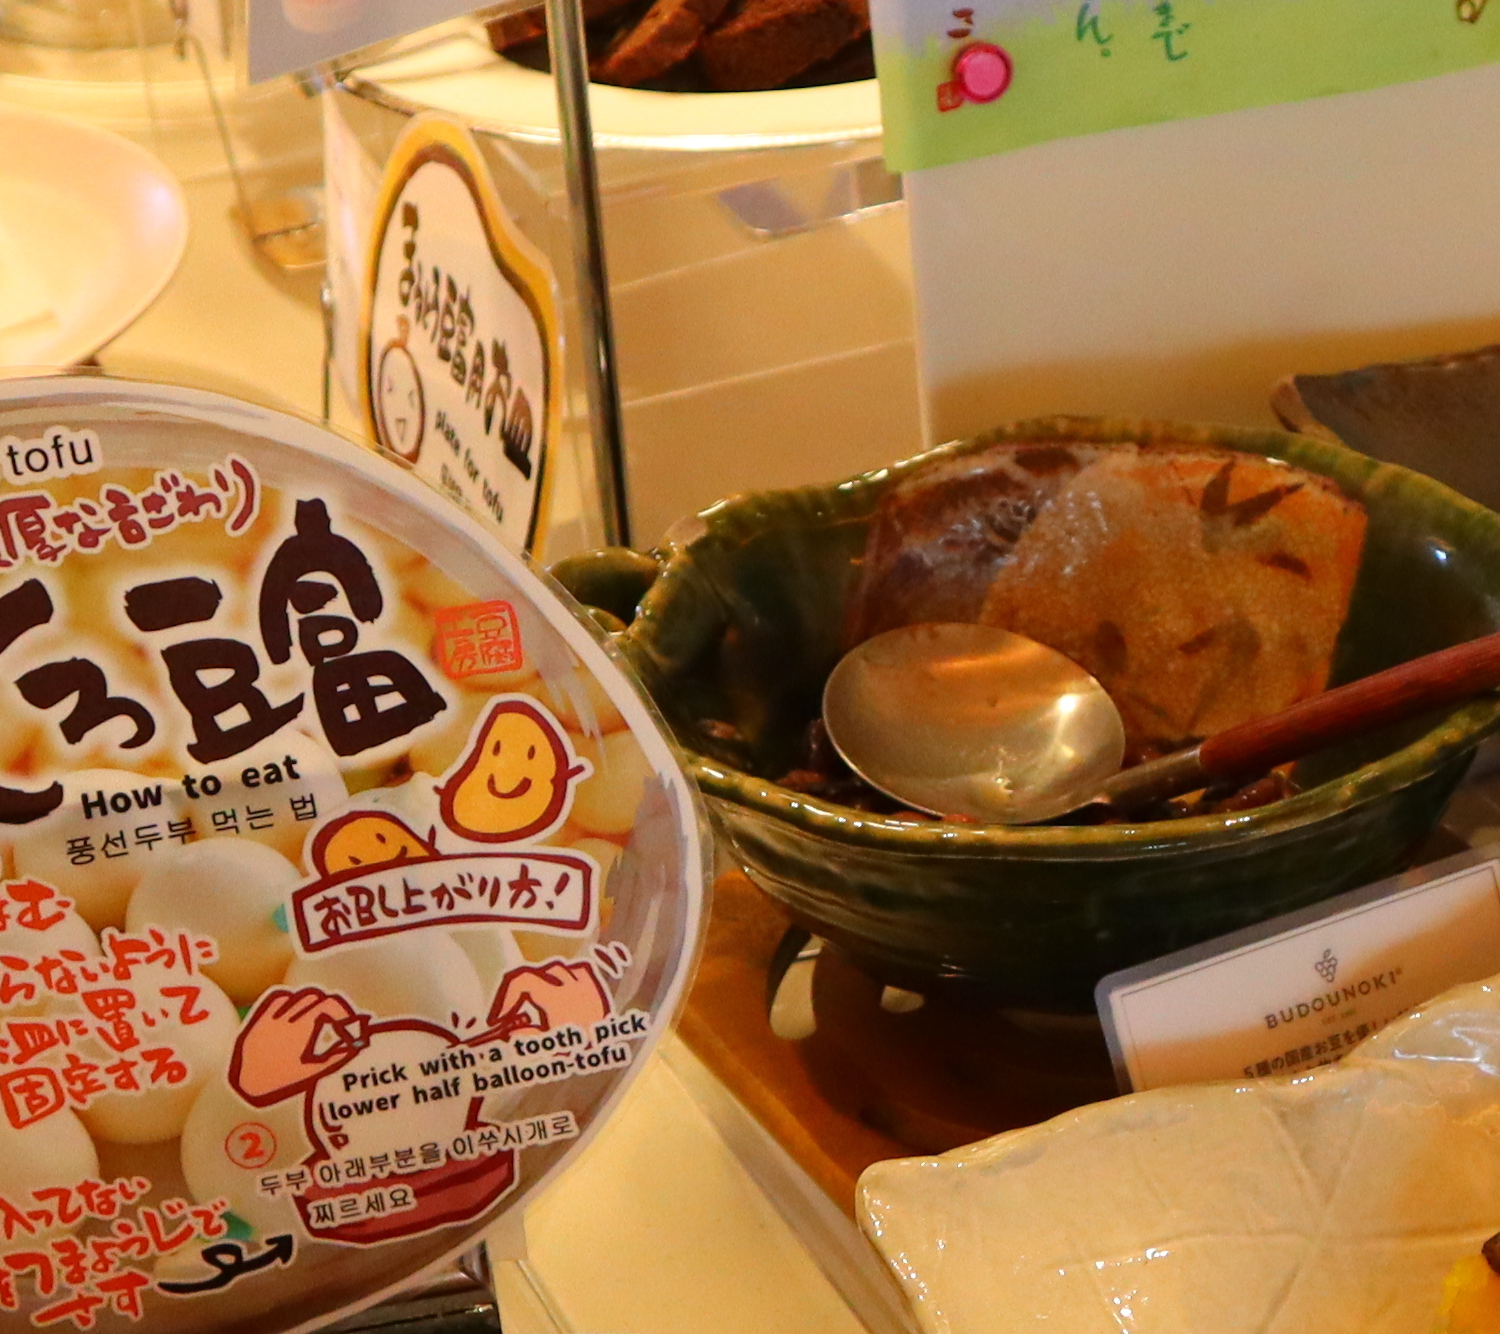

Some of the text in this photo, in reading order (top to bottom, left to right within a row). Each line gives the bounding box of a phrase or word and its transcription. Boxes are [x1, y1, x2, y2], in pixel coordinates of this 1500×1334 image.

[7, 433, 96, 477] tofu
[81, 756, 300, 819] How to eat
[66, 792, 318, 865] 풍선두부 먹는 법
[314, 863, 570, 937] お召し上がり方！
[328, 1043, 628, 1124] lower half balloon-tofu
[342, 1013, 648, 1093] Prick with a tooth pick
[260, 1112, 577, 1197] 두부 아래부분을 이쑤시개로
[311, 1186, 415, 1228] 찌르세요
[31, 1271, 149, 1328] さす
